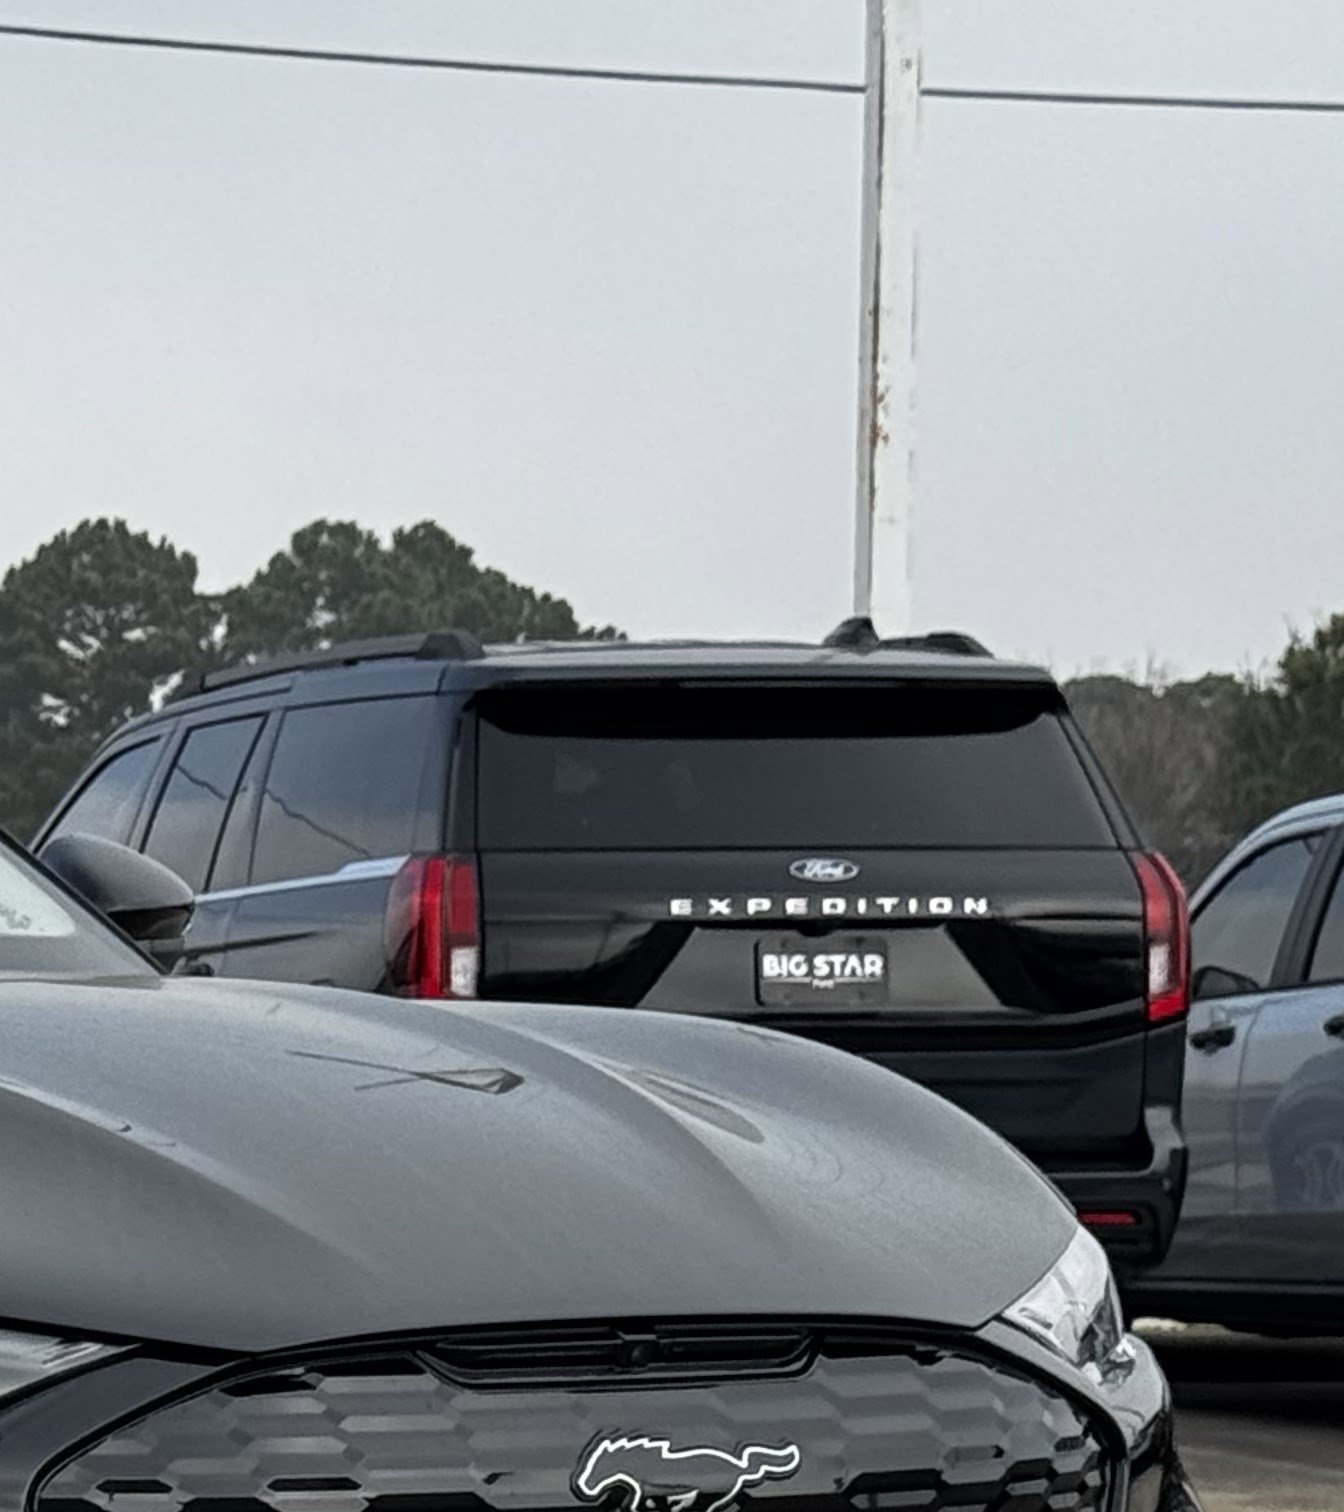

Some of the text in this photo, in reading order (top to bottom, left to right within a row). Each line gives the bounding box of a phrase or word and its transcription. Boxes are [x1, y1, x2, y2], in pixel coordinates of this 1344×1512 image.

[670, 896, 988, 916] EXPEDITION
[762, 953, 886, 978] BIG STAR
